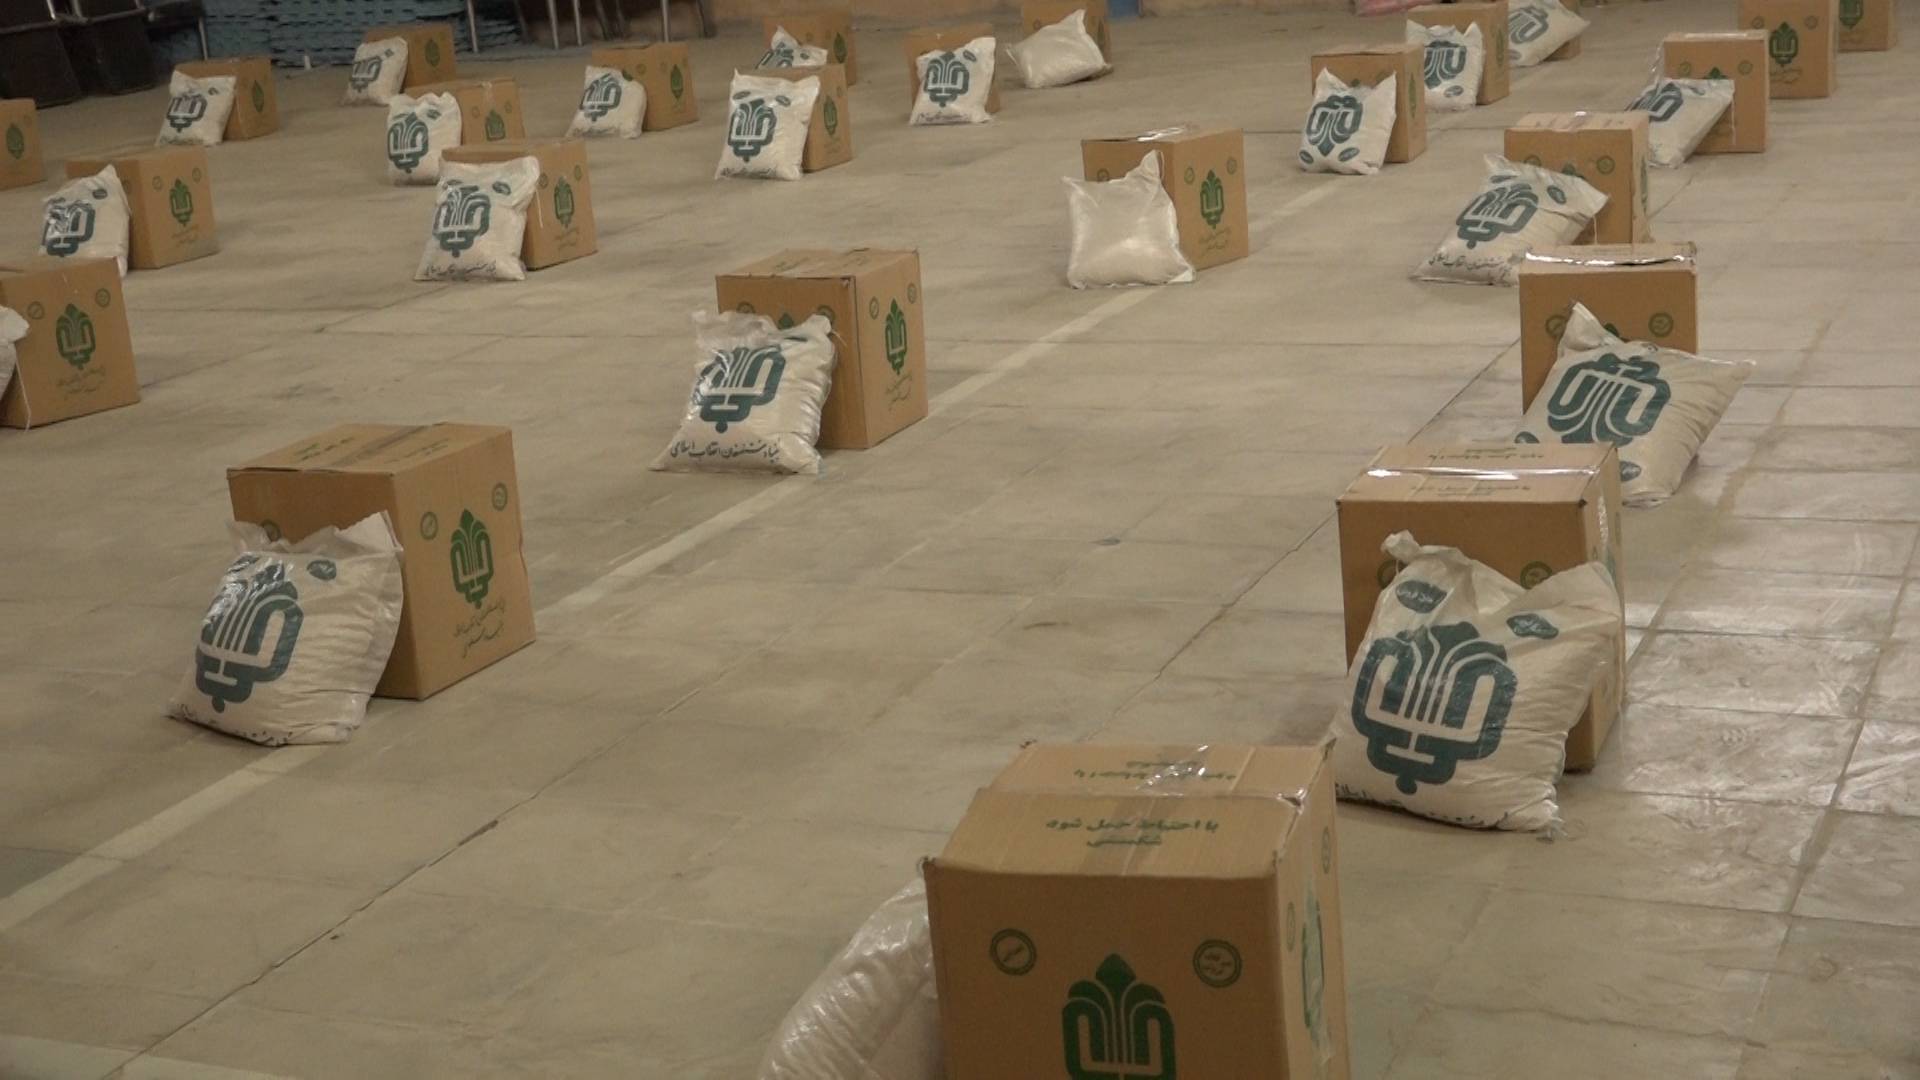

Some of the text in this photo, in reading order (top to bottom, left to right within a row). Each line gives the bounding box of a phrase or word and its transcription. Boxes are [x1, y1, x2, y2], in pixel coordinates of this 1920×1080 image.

[1086, 818, 1132, 832] حمل
[1136, 818, 1201, 832] احتیاط
[1204, 819, 1220, 834] با
